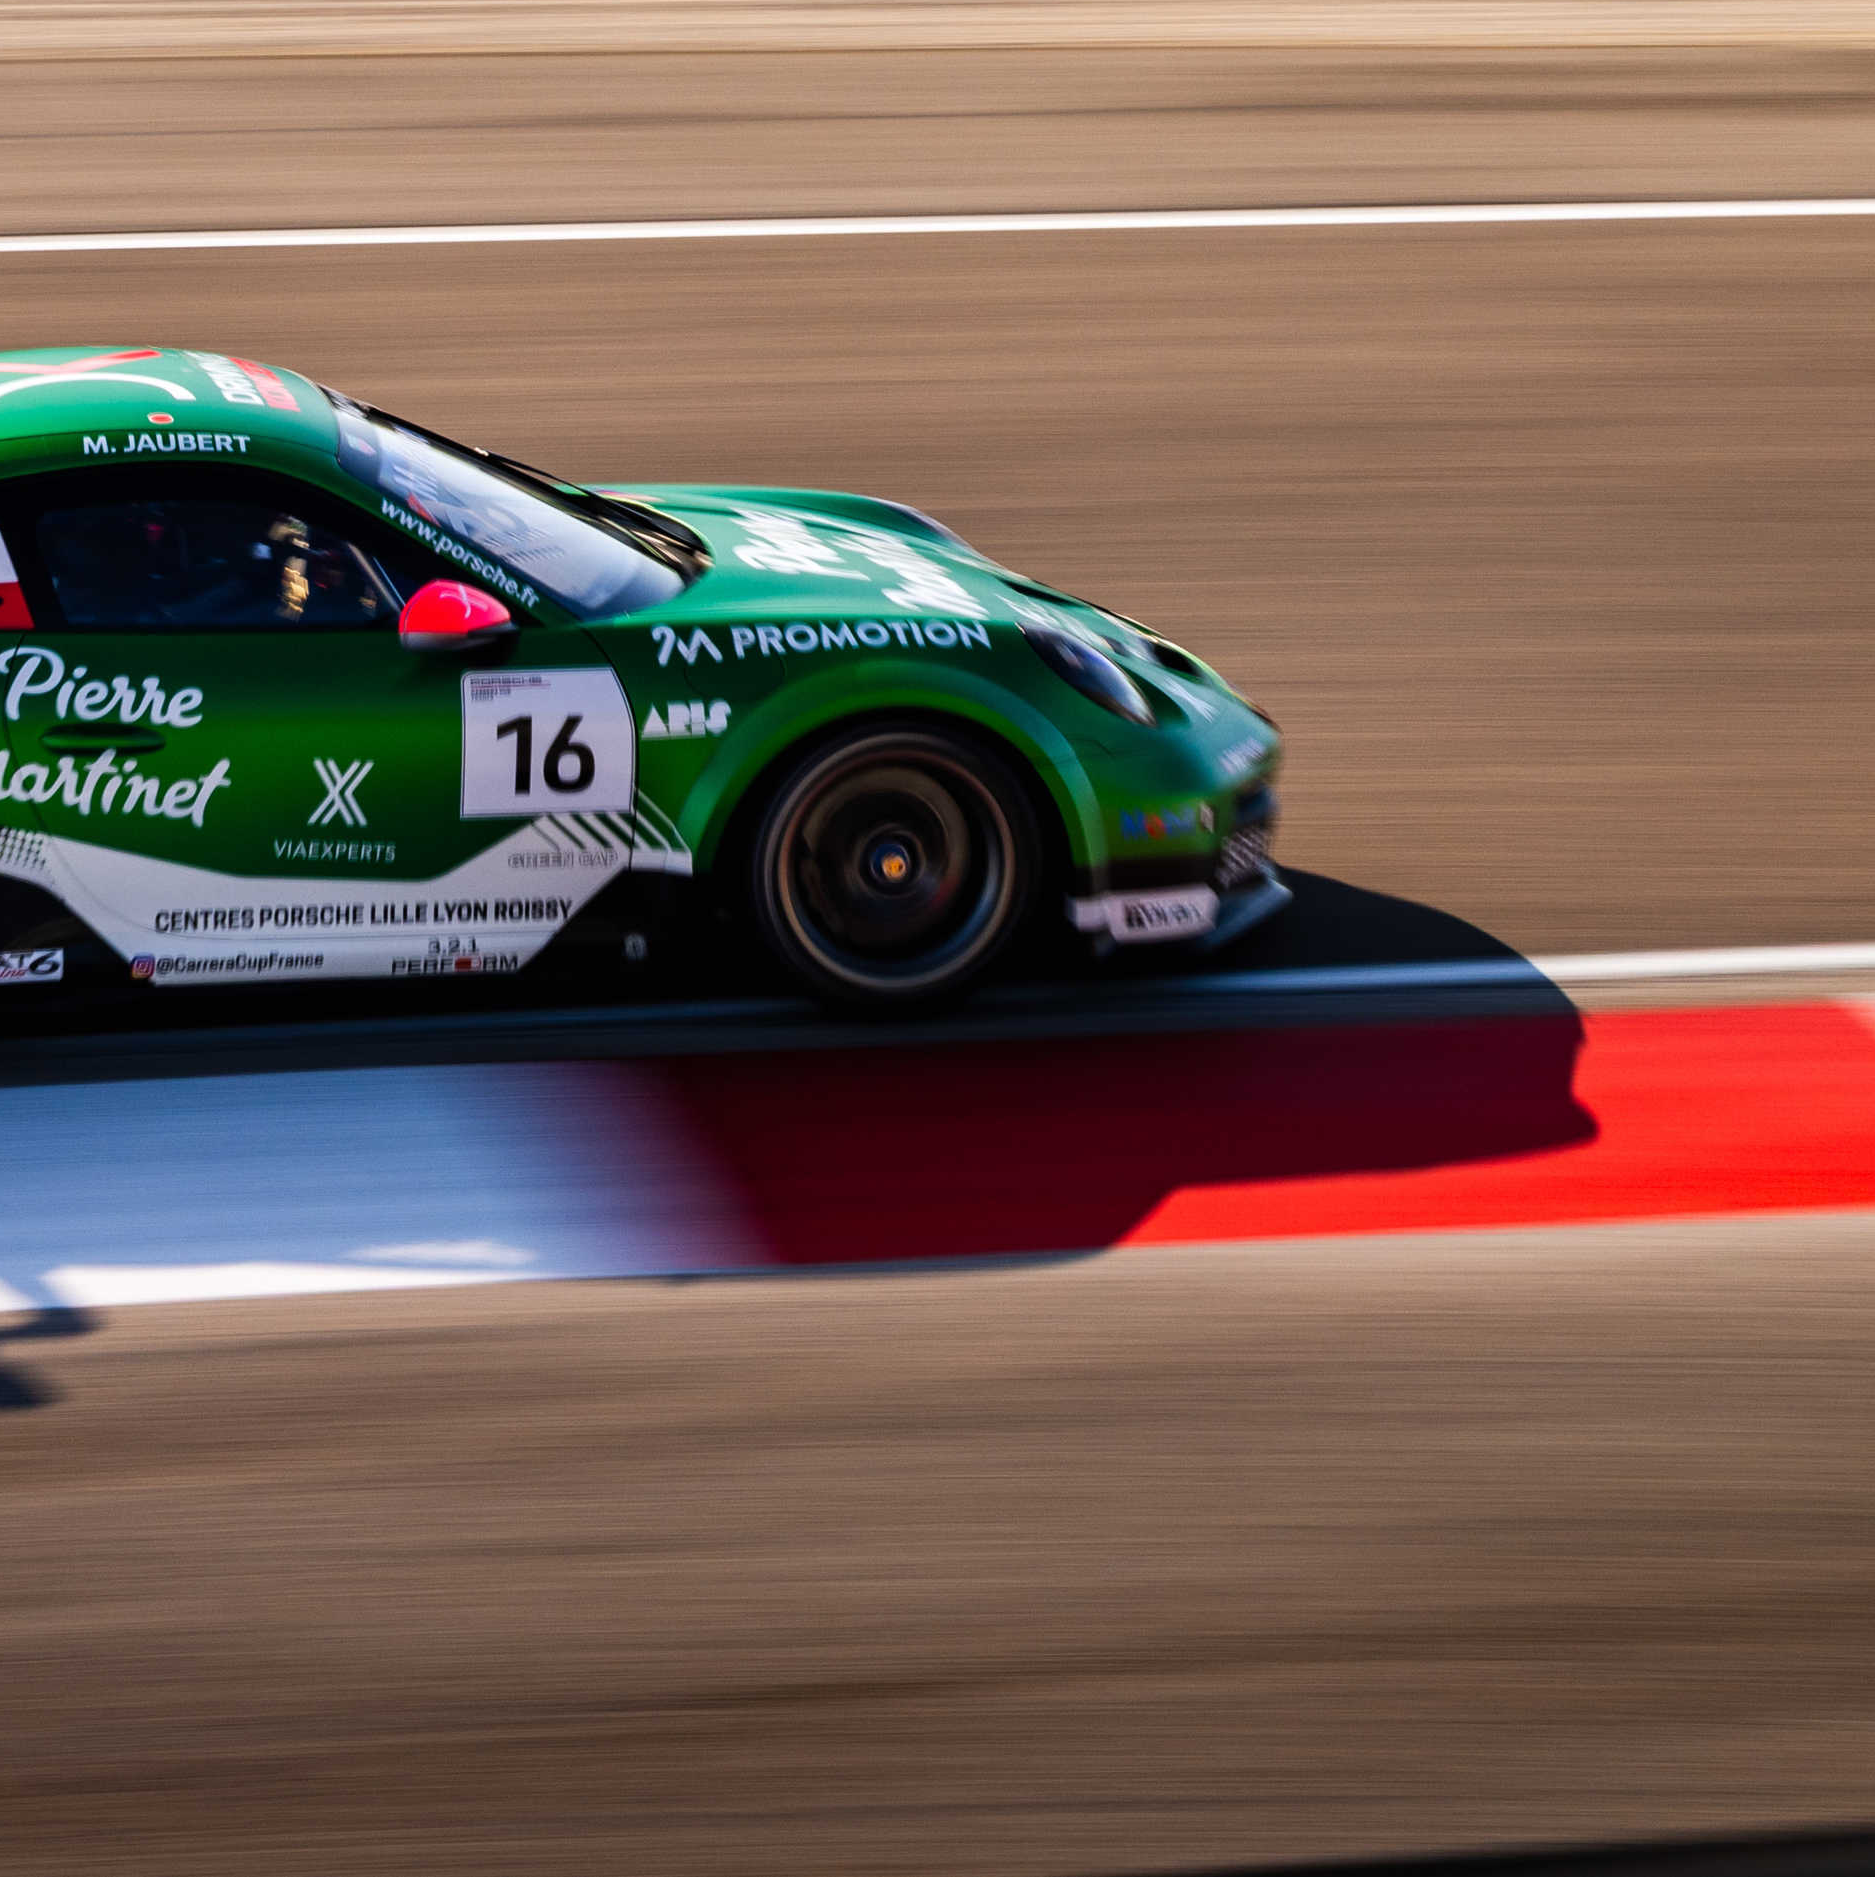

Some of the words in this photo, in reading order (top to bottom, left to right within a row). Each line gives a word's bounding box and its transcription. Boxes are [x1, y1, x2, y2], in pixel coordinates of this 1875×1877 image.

[83, 435, 116, 455] M.
[123, 433, 251, 454] JAUBERT
[380, 496, 539, 609] www.porsche.fr
[731, 620, 992, 660] PROMOTION
[496, 715, 596, 796] 16
[273, 840, 397, 863] VIAEXPERTS
[155, 908, 254, 933] CENTRES
[259, 903, 365, 928] PORSCHE
[370, 901, 428, 925] LILLE
[433, 899, 488, 923] LYON
[494, 897, 573, 922] ROISSY
[156, 952, 324, 976] @CarreraCupFrance
